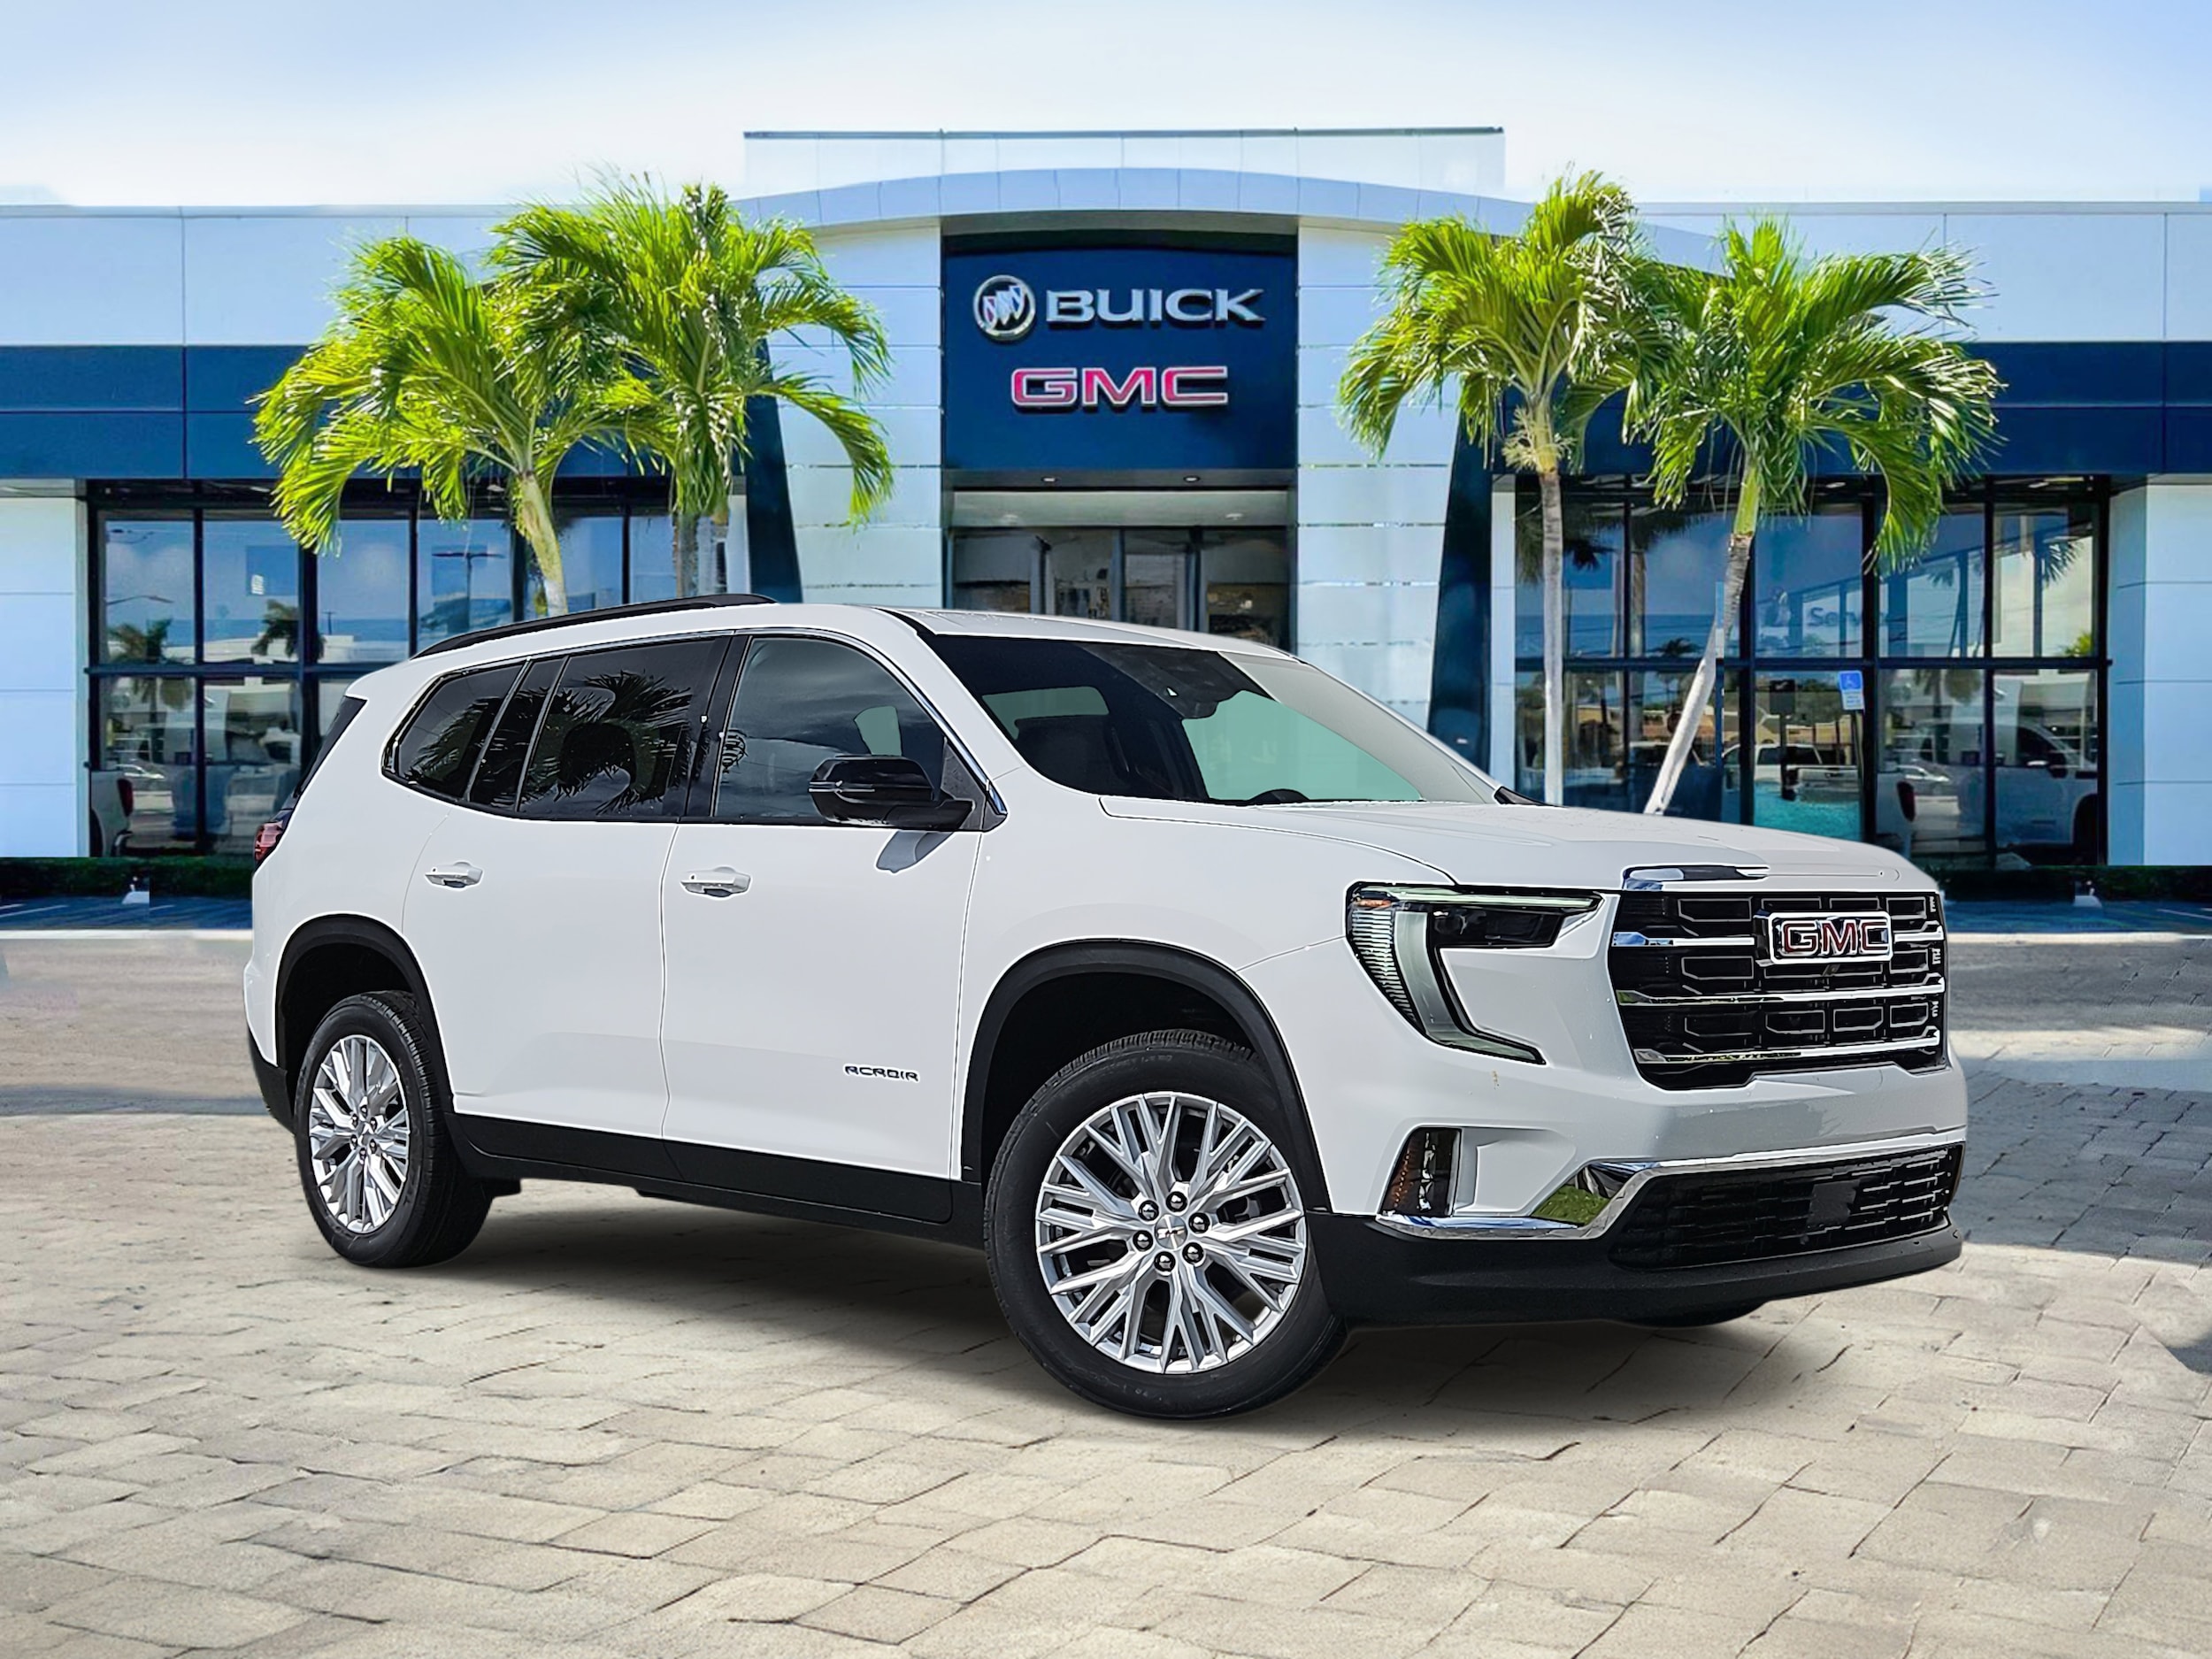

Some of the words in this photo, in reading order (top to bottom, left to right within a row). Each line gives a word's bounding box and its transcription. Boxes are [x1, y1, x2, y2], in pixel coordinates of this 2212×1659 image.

[1046, 288, 1266, 322] BUICK
[1010, 365, 1228, 406] GMC
[1781, 919, 1890, 956] GMC
[844, 1065, 919, 1082] ACADIA
